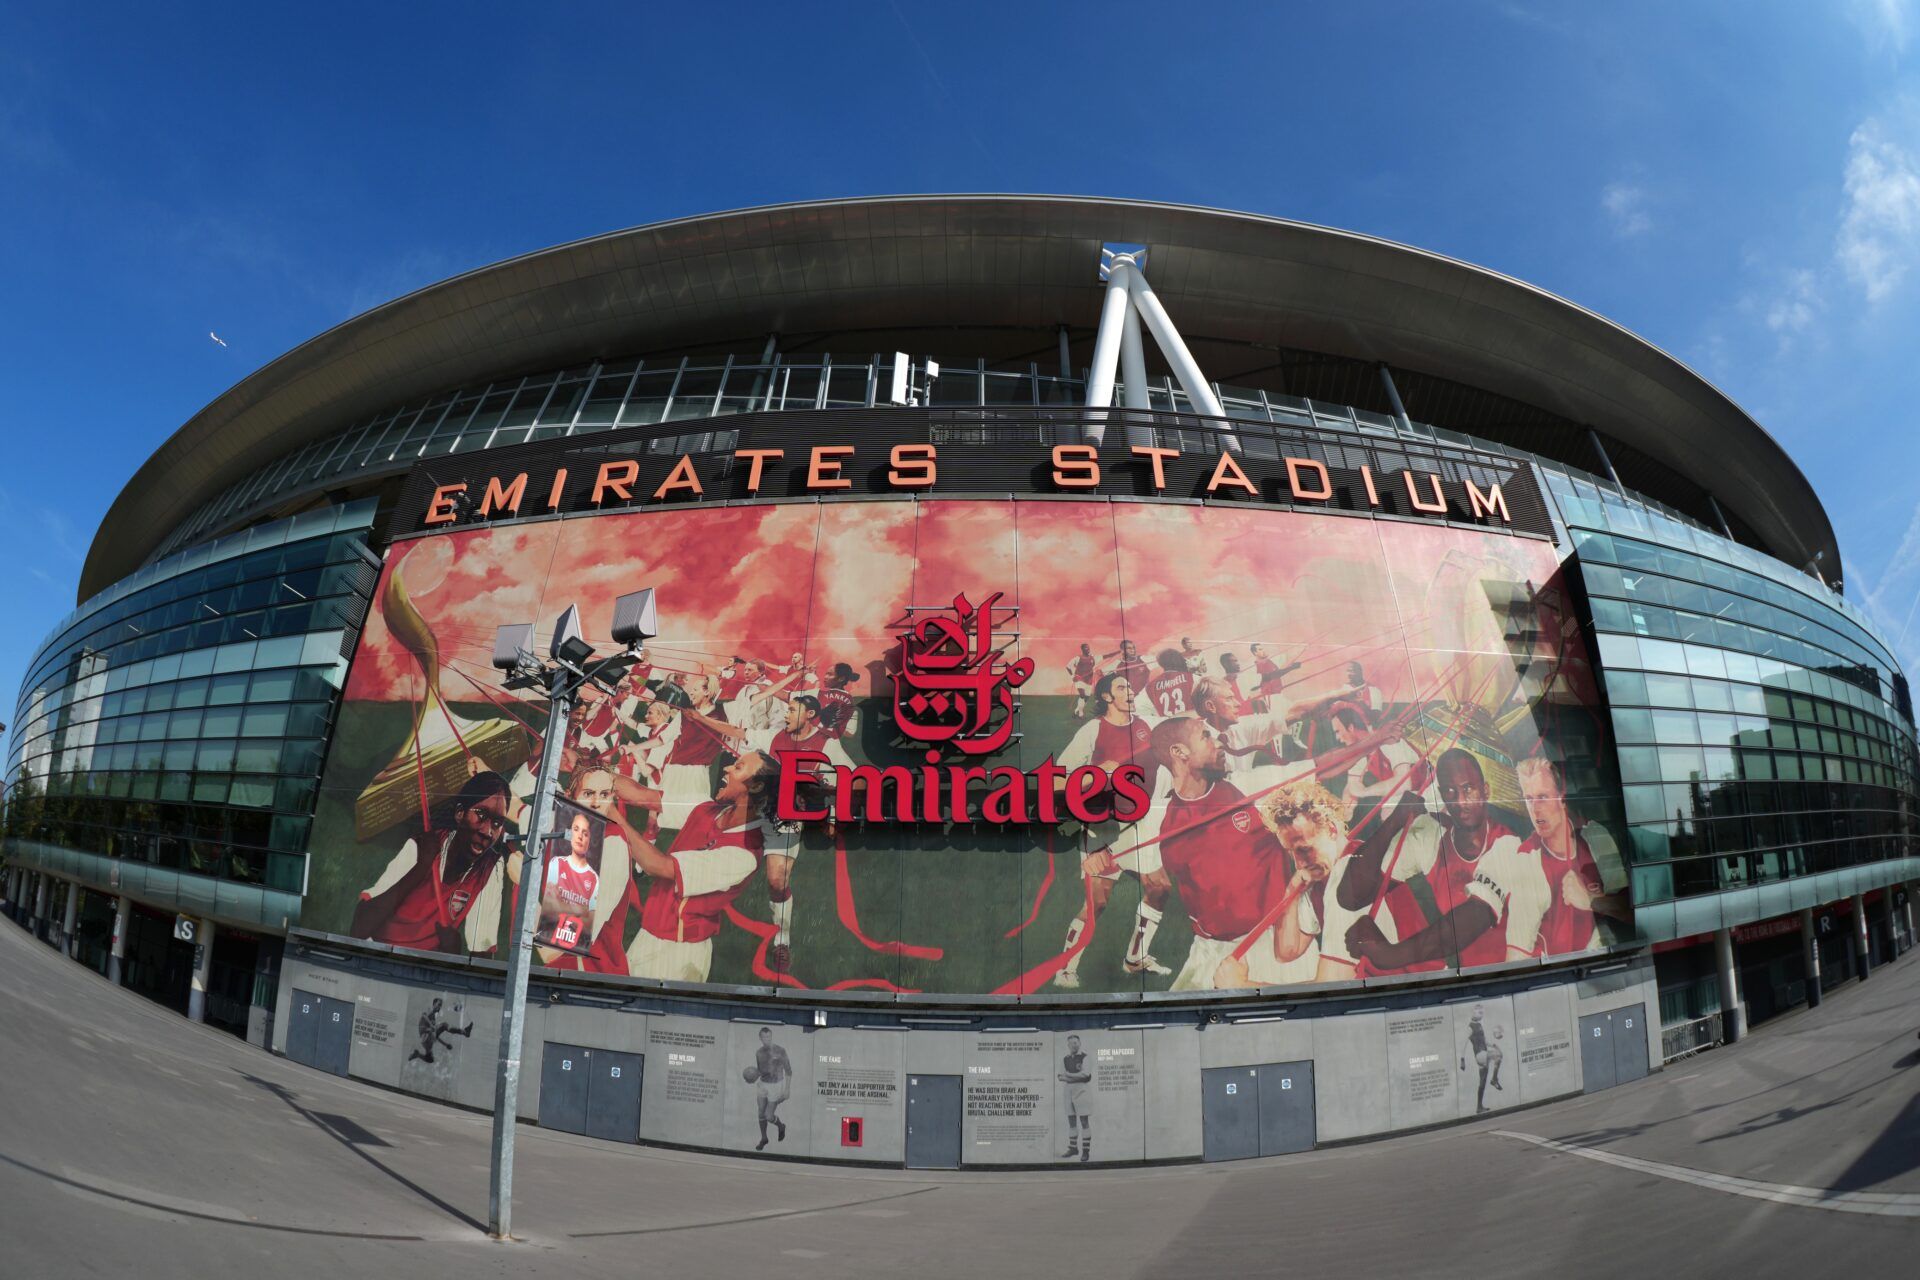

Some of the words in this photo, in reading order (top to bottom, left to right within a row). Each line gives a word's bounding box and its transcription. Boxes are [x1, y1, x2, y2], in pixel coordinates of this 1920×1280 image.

[424, 444, 937, 524] EMIRATES
[1052, 444, 1511, 522] STADIUM
[1159, 688, 1186, 717] 23
[776, 749, 1152, 825] Emirates
[181, 921, 193, 940] S
[556, 927, 577, 943] LITTLE
[1820, 916, 1831, 932] R
